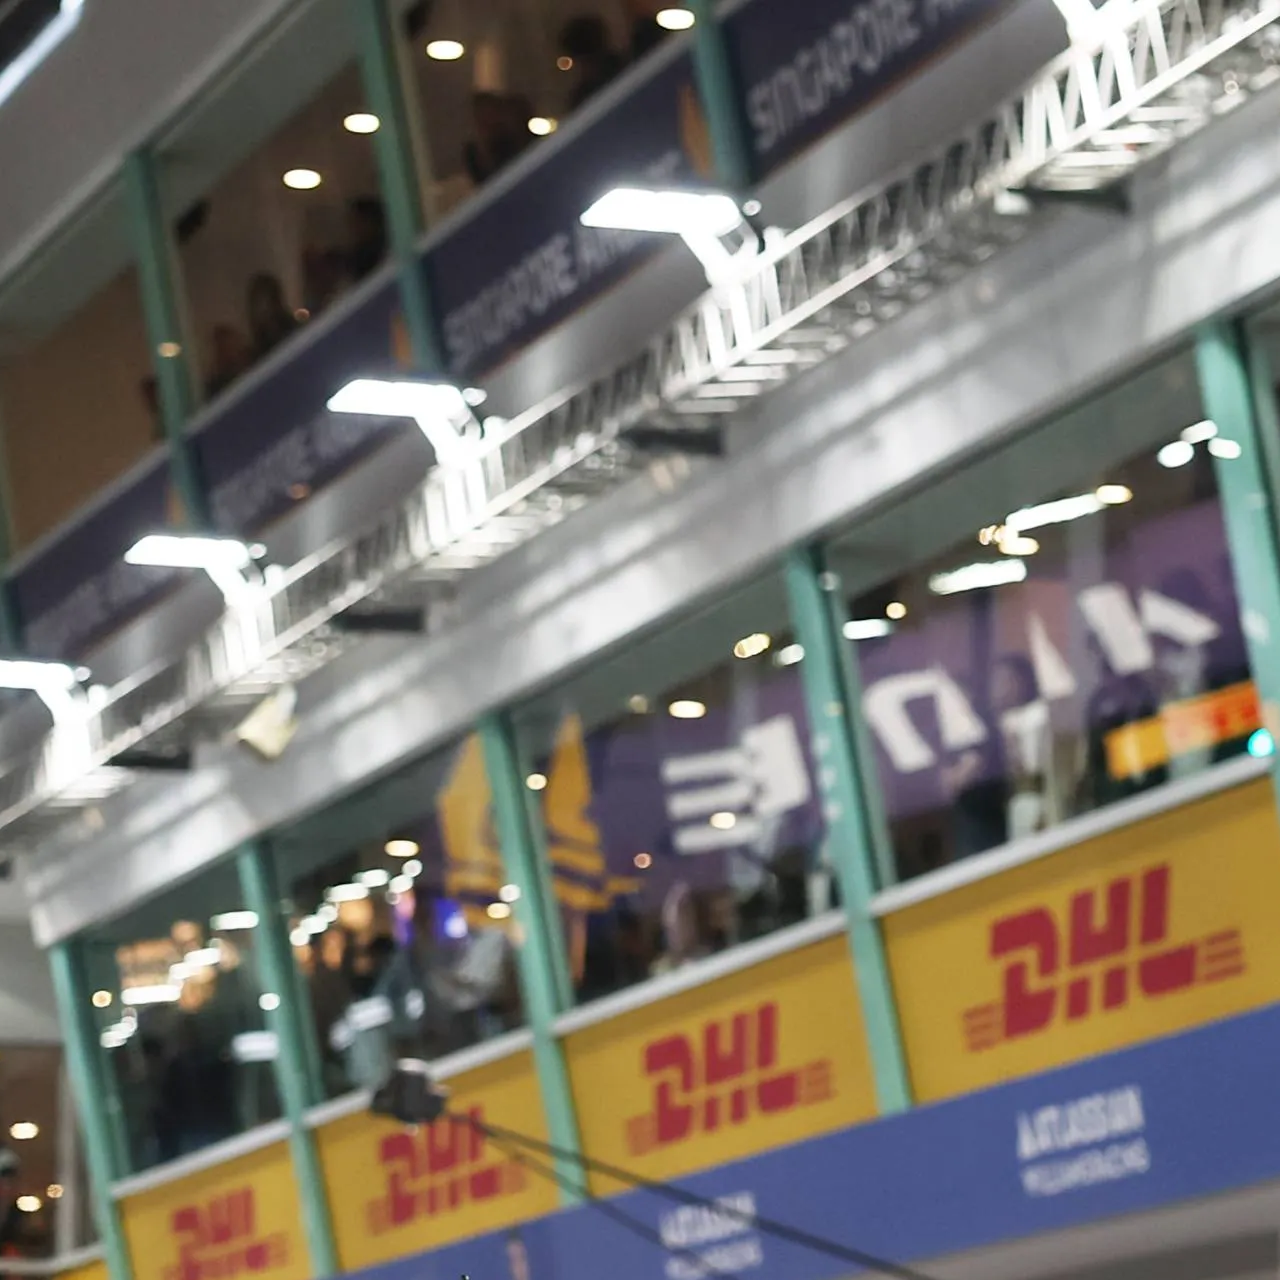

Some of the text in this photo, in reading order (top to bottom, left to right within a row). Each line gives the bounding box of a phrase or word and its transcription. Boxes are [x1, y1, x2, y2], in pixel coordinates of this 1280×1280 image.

[989, 863, 1198, 1040] DHL
[643, 1001, 798, 1144] DHL
[379, 1104, 501, 1227] DHL
